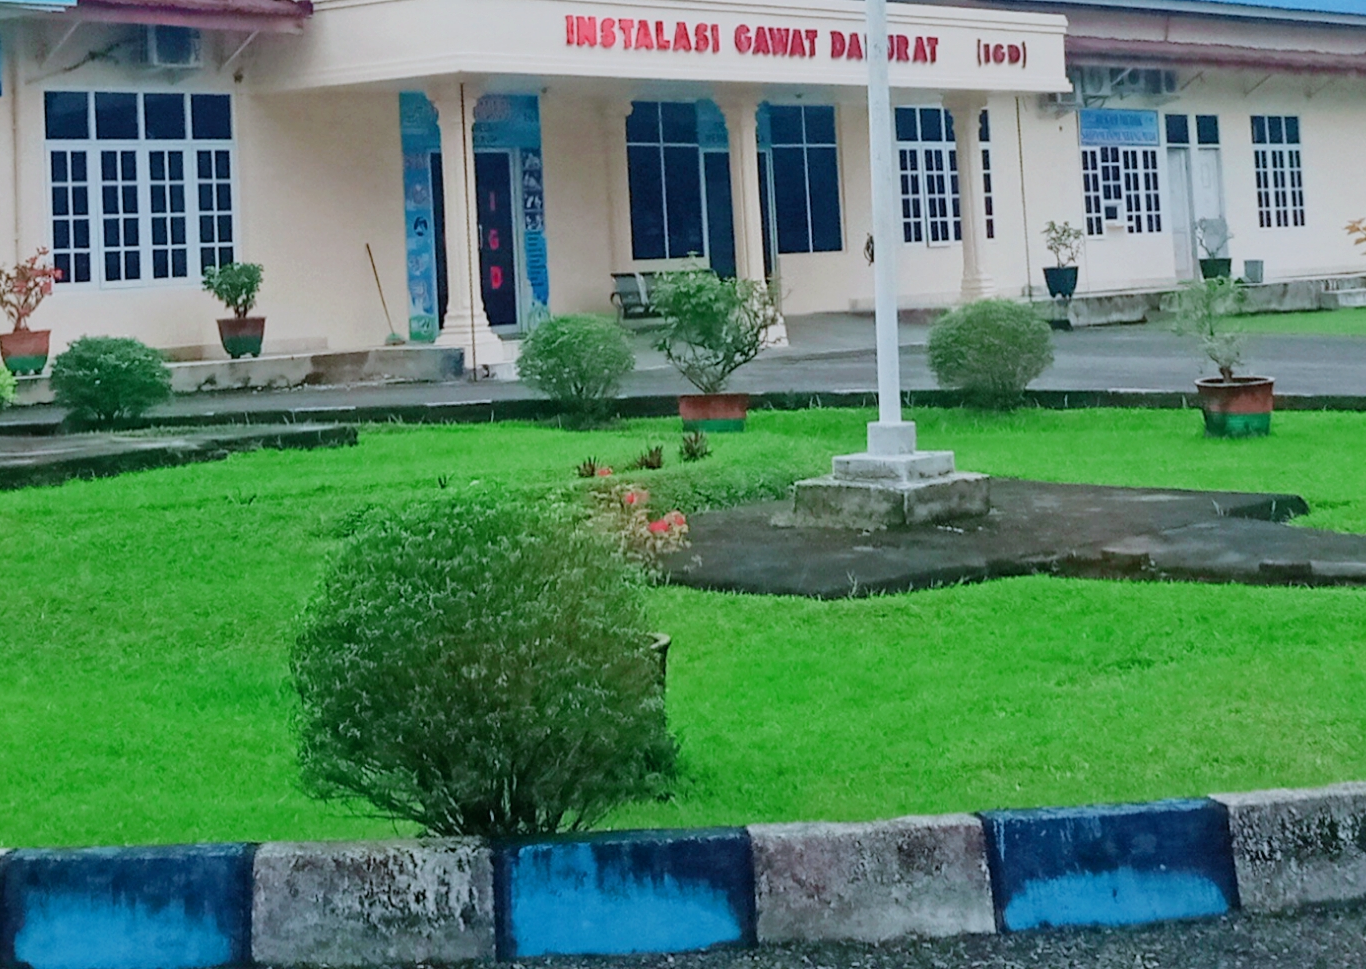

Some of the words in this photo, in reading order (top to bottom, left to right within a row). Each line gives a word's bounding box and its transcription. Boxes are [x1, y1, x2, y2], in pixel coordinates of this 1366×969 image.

[565, 15, 720, 53] INSTALASI
[734, 24, 818, 58] GAWAT
[977, 38, 1026, 69] (IGD)
